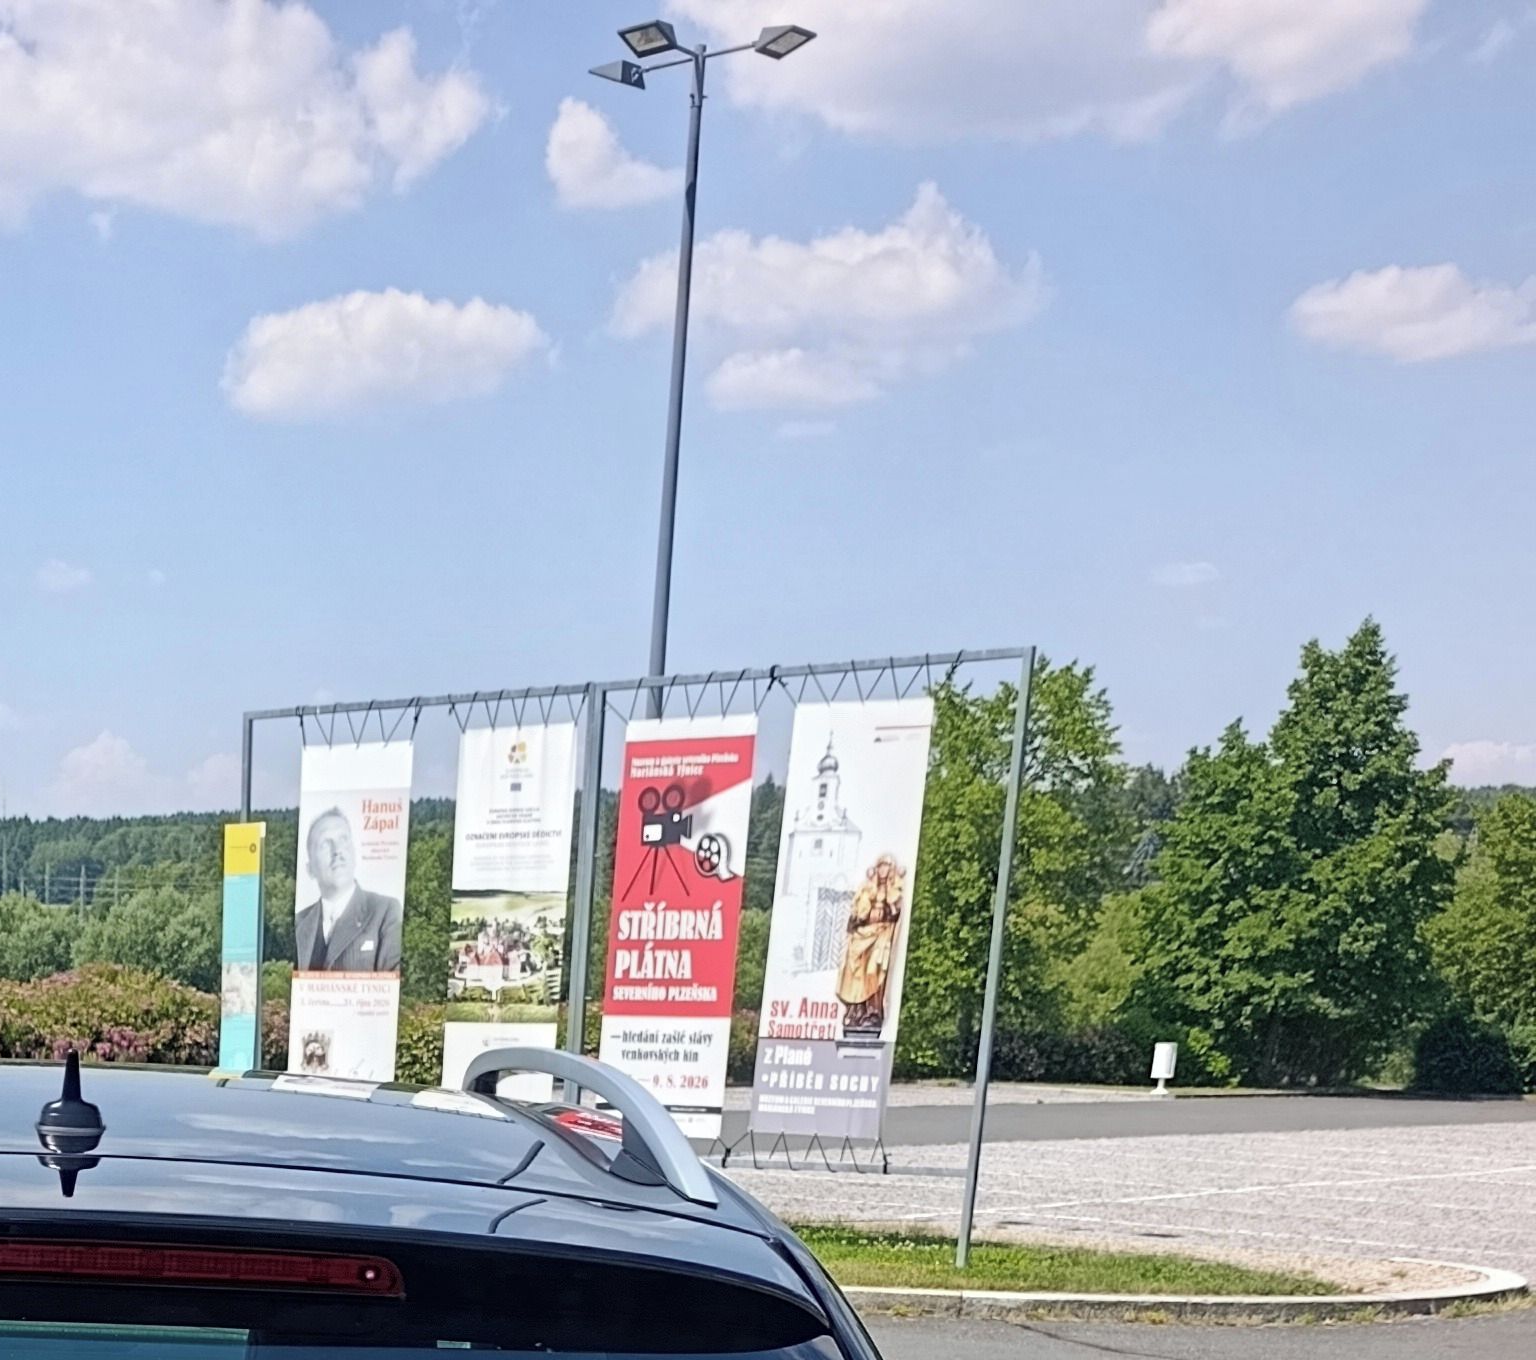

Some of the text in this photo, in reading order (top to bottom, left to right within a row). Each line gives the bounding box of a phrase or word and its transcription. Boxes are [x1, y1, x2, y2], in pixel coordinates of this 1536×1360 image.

[362, 798, 403, 814] Hanuš
[363, 815, 399, 832] Zápal
[618, 900, 723, 940] STŘÍBRNÁ
[614, 941, 692, 979] PLÁTNA
[613, 982, 717, 1001] SEVERNÍHO PLZEŇSKA
[770, 997, 839, 1019] sv. Anna
[661, 1030, 686, 1045] zašlé
[688, 1030, 713, 1047] slávy
[622, 1048, 699, 1064] venkovských kin
[774, 1045, 813, 1066] Plané
[680, 1075, 709, 1089] 2026
[829, 1074, 880, 1092] SOCHY
